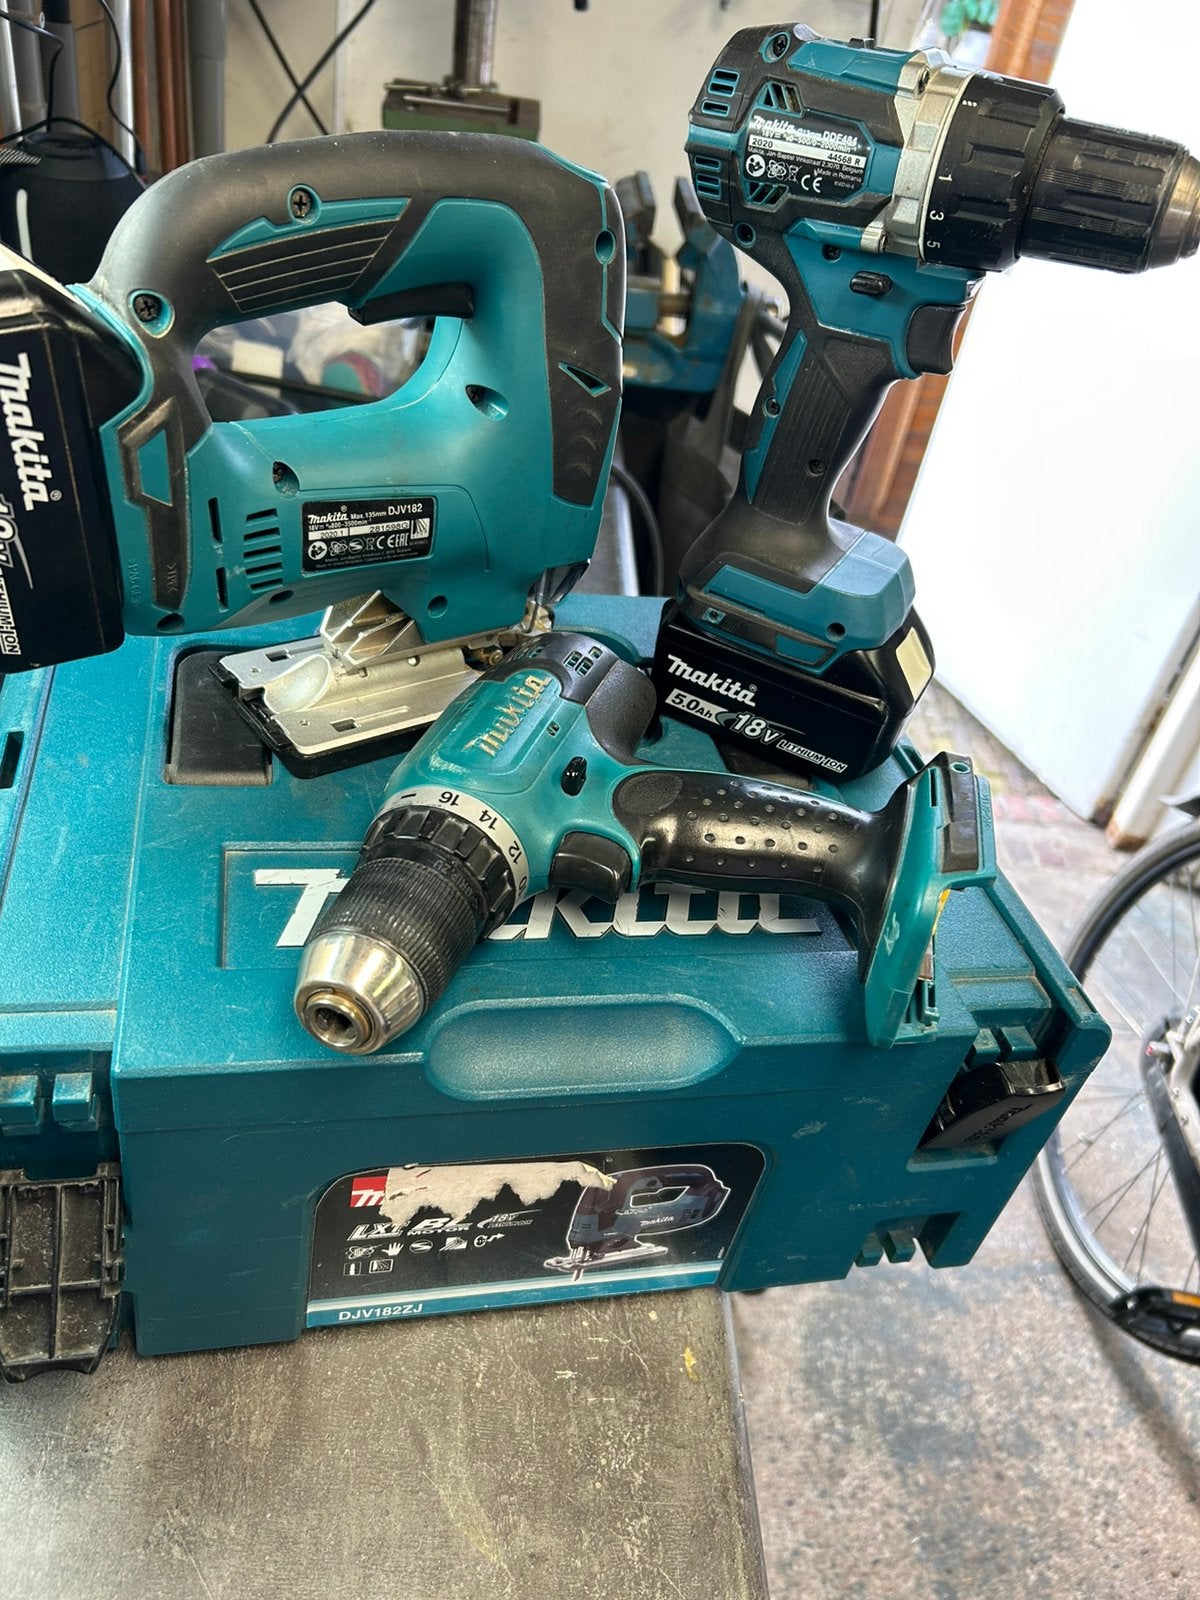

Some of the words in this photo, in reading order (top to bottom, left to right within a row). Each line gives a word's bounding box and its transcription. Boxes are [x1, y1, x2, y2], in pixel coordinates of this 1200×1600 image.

[752, 138, 774, 149] 2020
[828, 153, 853, 164] 44568
[854, 158, 861, 167] R
[938, 173, 953, 182] 1
[929, 210, 945, 221] 3
[926, 240, 941, 249] 5
[387, 503, 423, 516] DJV182
[369, 522, 409, 534] 281598G
[671, 692, 713, 720] 5.0Ah
[776, 739, 849, 774] LITHIUM-ION
[438, 790, 461, 807] 16
[478, 808, 499, 831] 14
[508, 839, 523, 866] 12
[406, 1226, 470, 1237] MOTOR
[338, 1303, 424, 1321] DJV182ZJ
